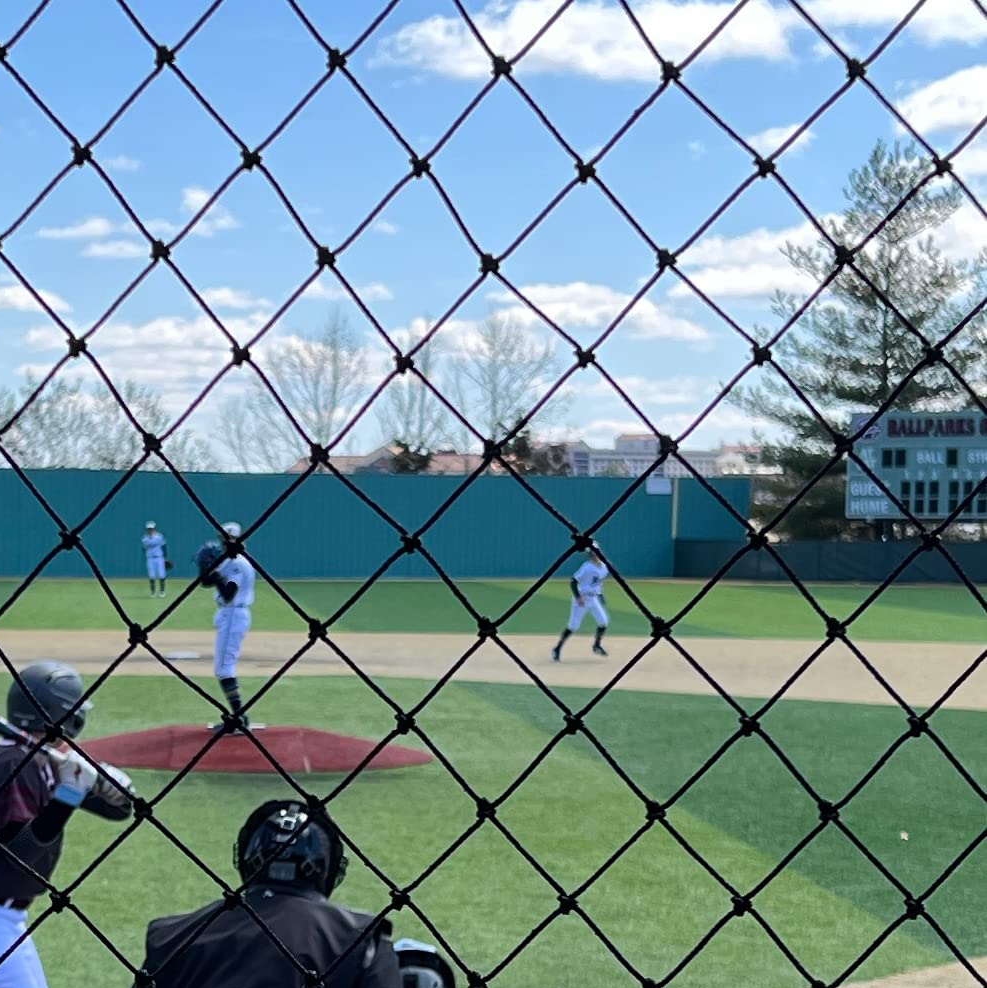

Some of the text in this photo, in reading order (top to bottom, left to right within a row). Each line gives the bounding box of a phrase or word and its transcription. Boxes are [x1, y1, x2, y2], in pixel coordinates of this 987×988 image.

[888, 418, 976, 437] BALLPARKS
[916, 449, 944, 465] BALL
[851, 481, 891, 497] GUES
[851, 501, 889, 514] HOME
